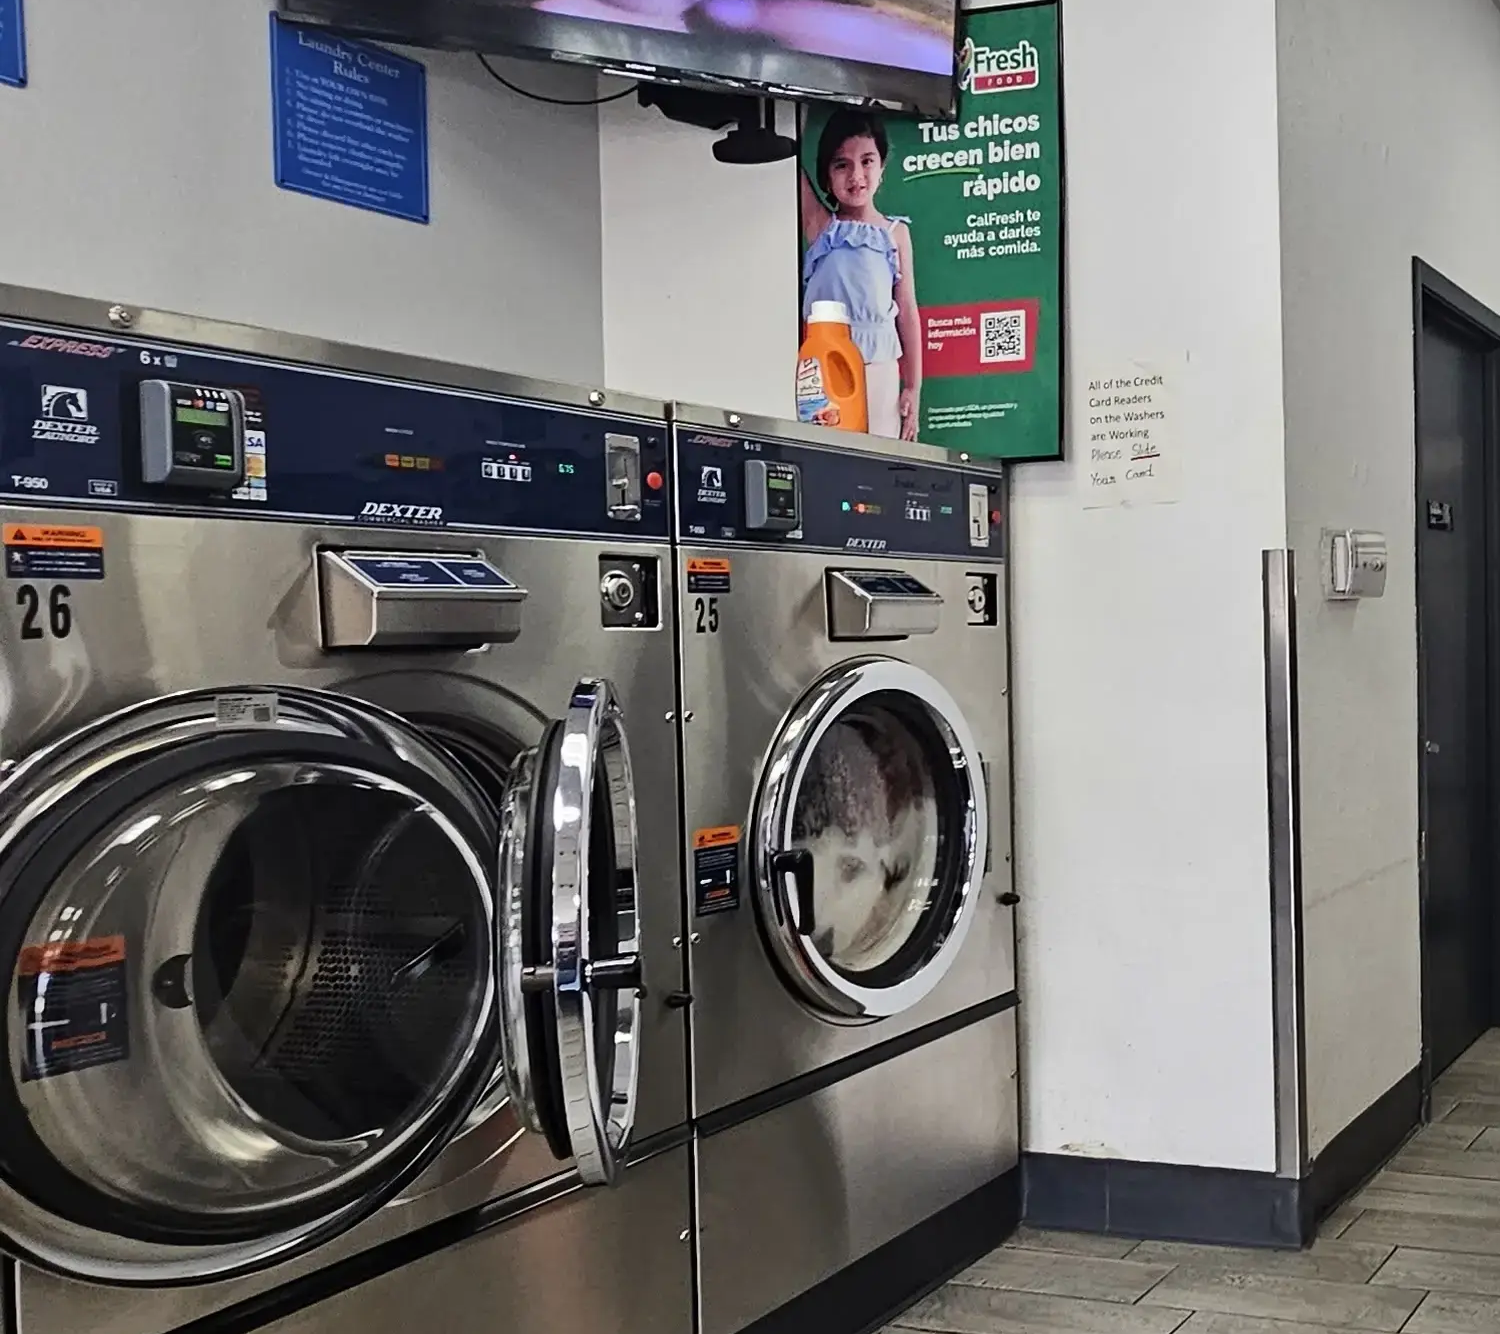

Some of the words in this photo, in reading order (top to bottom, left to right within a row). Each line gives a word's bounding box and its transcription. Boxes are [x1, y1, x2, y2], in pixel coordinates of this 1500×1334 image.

[297, 31, 352, 62] Laundry
[357, 52, 401, 79] Center
[333, 60, 370, 84] Rules
[987, 75, 1023, 87] FOOD
[919, 122, 960, 143] Tus
[964, 114, 1040, 138] chicos
[903, 148, 983, 172] crecen
[988, 140, 1040, 164] bien
[963, 170, 1040, 200] rápido
[967, 210, 1023, 227] CalFresh
[1027, 209, 1041, 221] te
[944, 229, 984, 247] ayuda
[987, 231, 995, 241] a
[999, 225, 1041, 240] darles
[957, 246, 985, 259] más
[988, 240, 1041, 256] comida.
[928, 318, 953, 327] Busca
[20, 335, 116, 359] EXPRESS
[139, 351, 150, 365] 6
[928, 341, 943, 351] hoy
[1088, 381, 1100, 390] All
[1103, 379, 1112, 389] of
[1116, 378, 1131, 388] the
[1133, 375, 1163, 387] Credit
[1089, 396, 1111, 407] Card
[1114, 394, 1152, 406] Readers
[1090, 416, 1102, 424] on
[1105, 413, 1121, 424] the
[1124, 410, 1164, 422] Washers
[32, 419, 100, 435] DEXTER
[1091, 432, 1106, 441] are
[1109, 428, 1149, 441] Working
[1091, 448, 1122, 462] Please
[1125, 464, 1154, 480] Card
[361, 502, 442, 520] DEXTER
[846, 537, 887, 549] DEXTER
[16, 584, 71, 640] 26
[695, 597, 719, 634] 25
